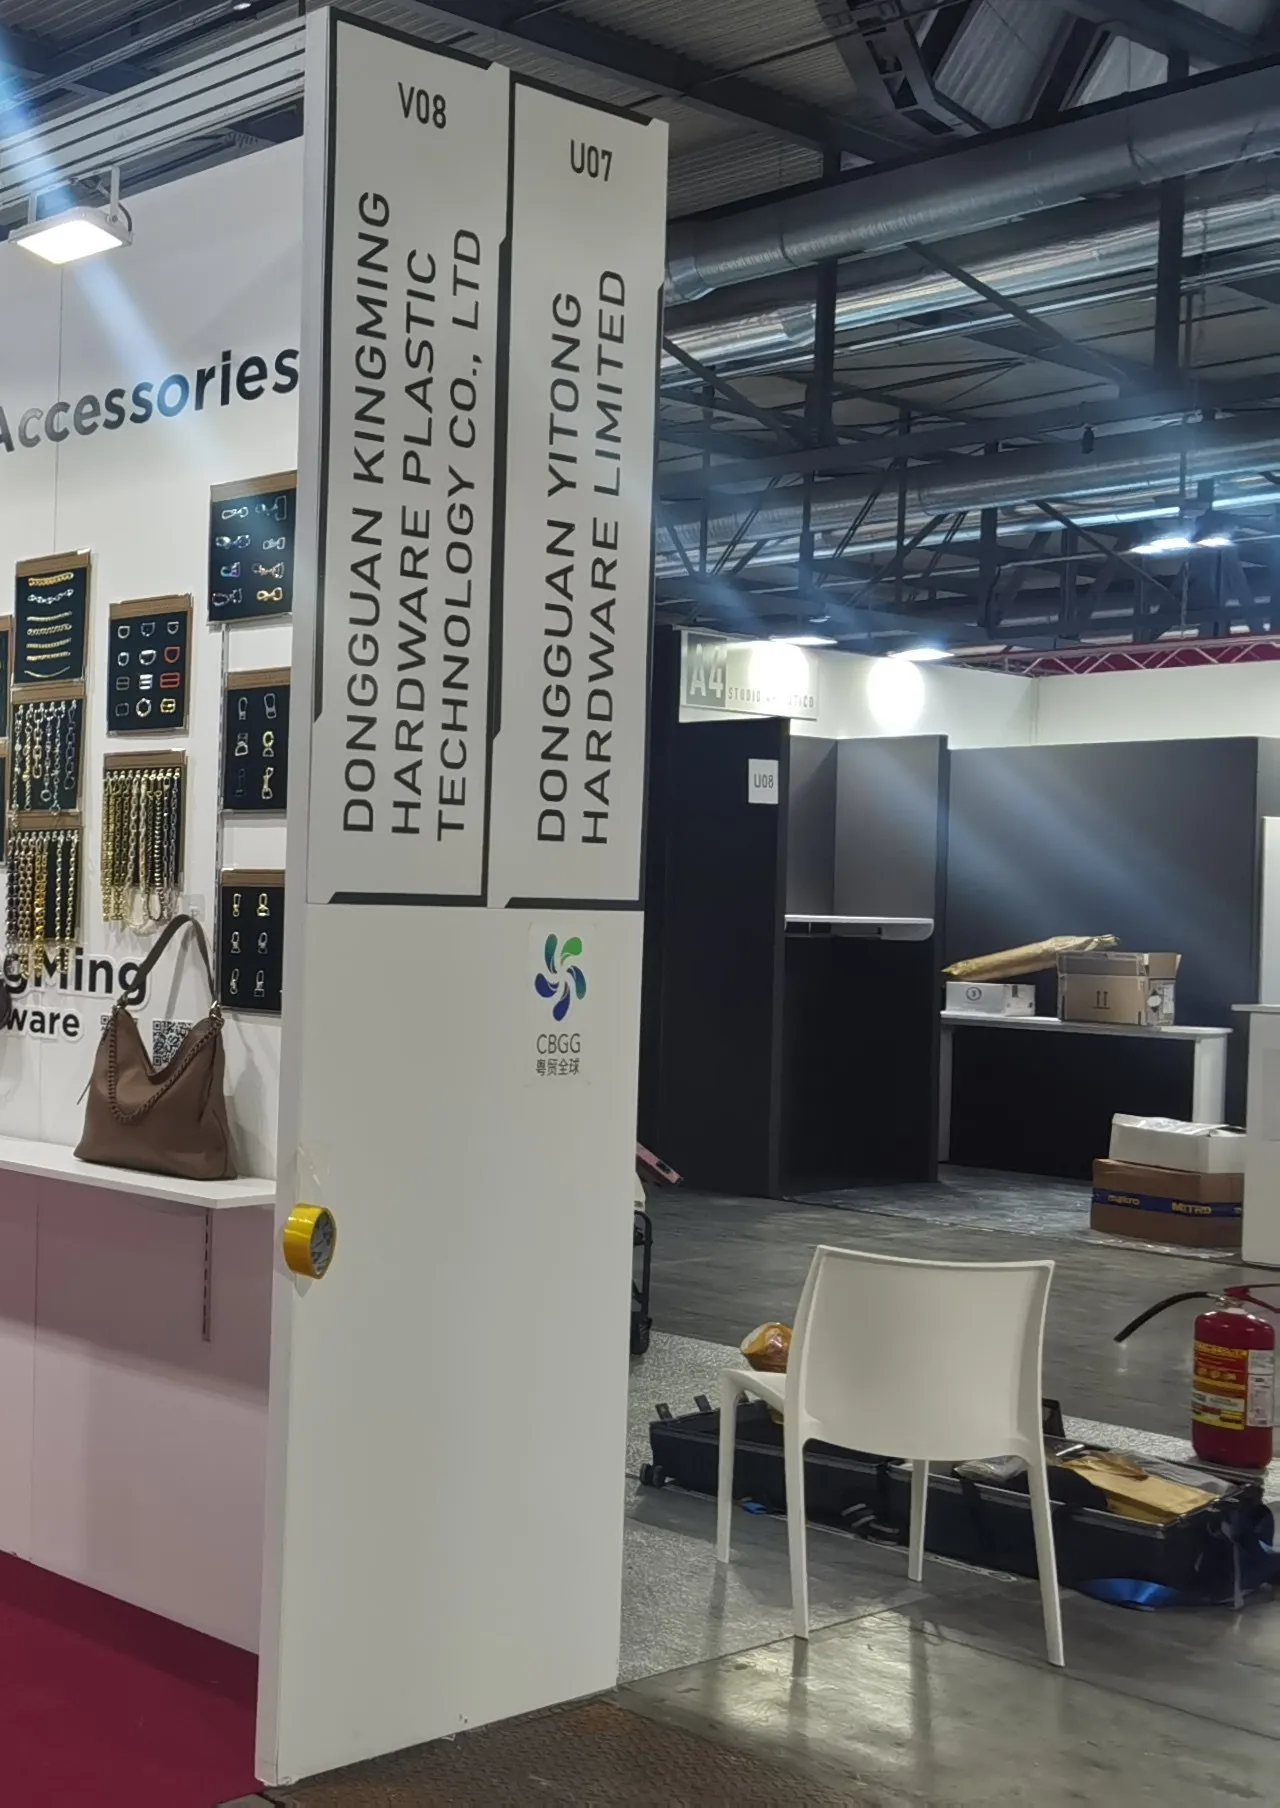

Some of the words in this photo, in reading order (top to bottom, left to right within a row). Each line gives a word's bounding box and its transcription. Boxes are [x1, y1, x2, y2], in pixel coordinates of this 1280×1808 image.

[397, 81, 447, 129] V08
[570, 138, 613, 182] U07
[451, 228, 481, 331] LTD
[352, 191, 390, 484] KINGMING
[402, 248, 436, 485] PLASTIC
[593, 269, 625, 497] LIMITED
[448, 353, 482, 450] CO.,
[547, 292, 582, 497] YITONG
[342, 507, 383, 832] DONGGUAN
[391, 504, 430, 834] HARDWARE
[436, 464, 475, 842] TECHNOLOGY
[537, 518, 576, 843] DONGGUAN
[581, 516, 619, 845] HARDWARE
[689, 643, 726, 699] A4
[728, 686, 760, 703] STUDIO
[753, 773, 774, 789] U08
[6, 1006, 81, 1038] ware
[535, 1057, 581, 1077] 粤贸全球
[536, 1032, 581, 1054] CBGG
